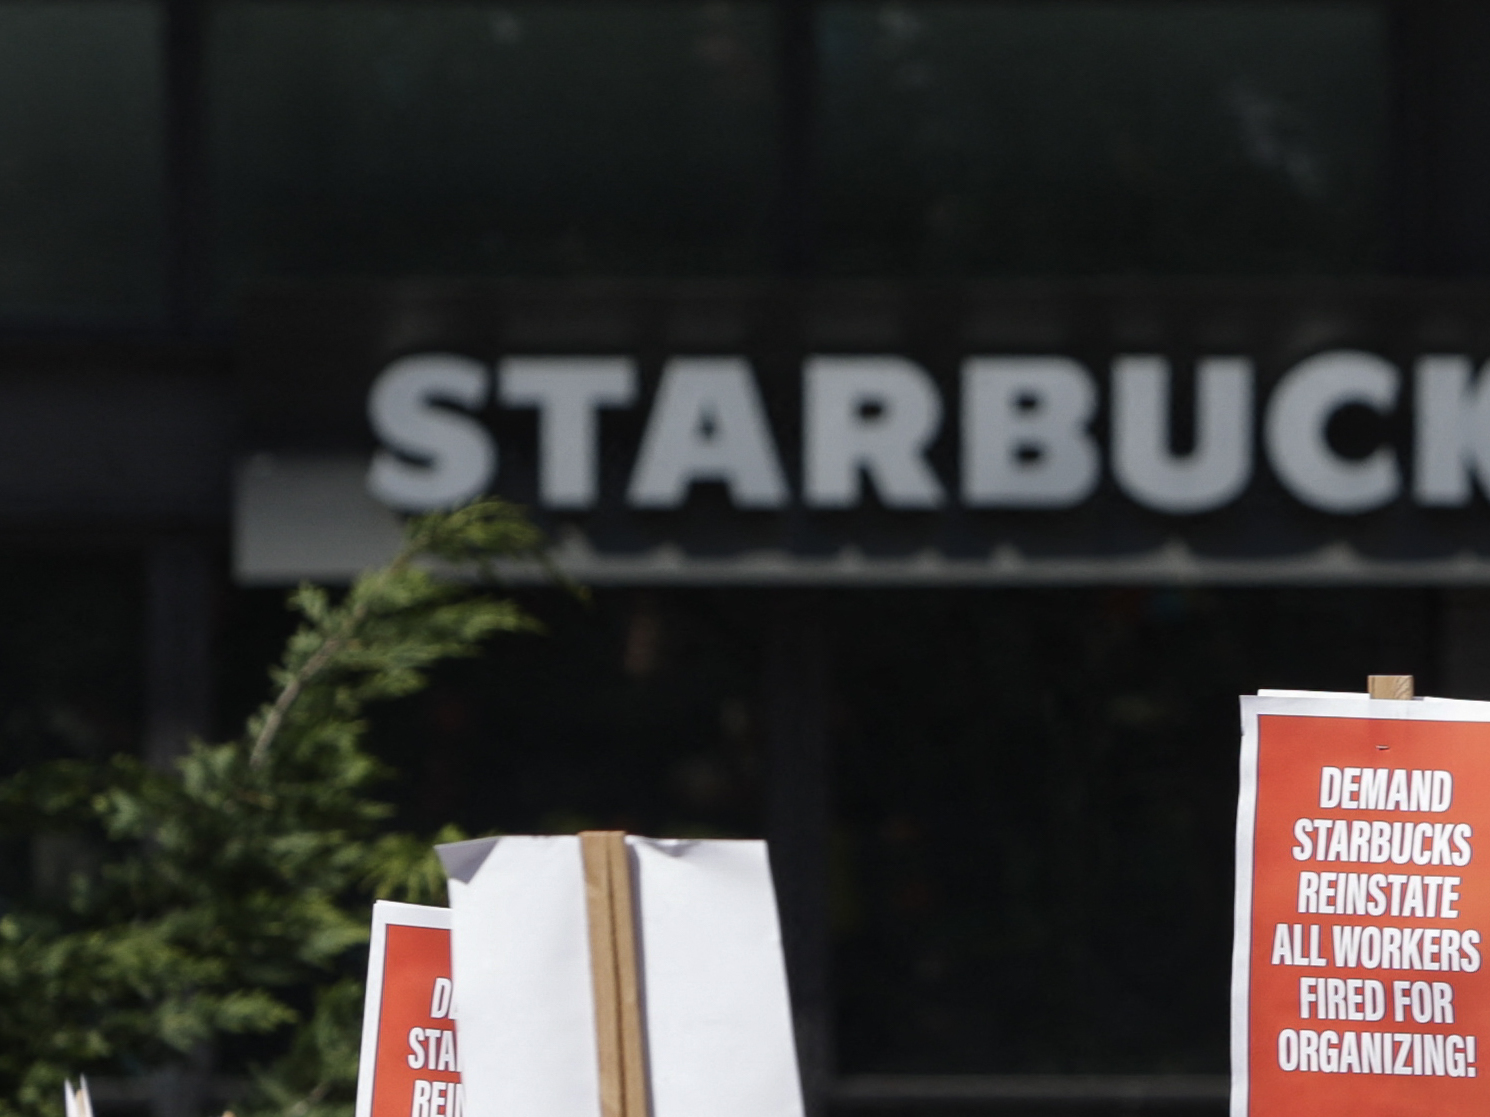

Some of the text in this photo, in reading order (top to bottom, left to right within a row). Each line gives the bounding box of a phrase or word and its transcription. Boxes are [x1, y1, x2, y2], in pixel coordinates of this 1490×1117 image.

[1319, 765, 1453, 814] DEMAND
[1291, 817, 1473, 868] STARBUCKS
[1297, 870, 1461, 920] REINSTATE
[1271, 922, 1482, 974] ALL WORKERS
[1299, 976, 1454, 1025] FIRED FOR
[408, 1027, 461, 1072] STA
[1277, 1028, 1477, 1079] ORGANIZING!
